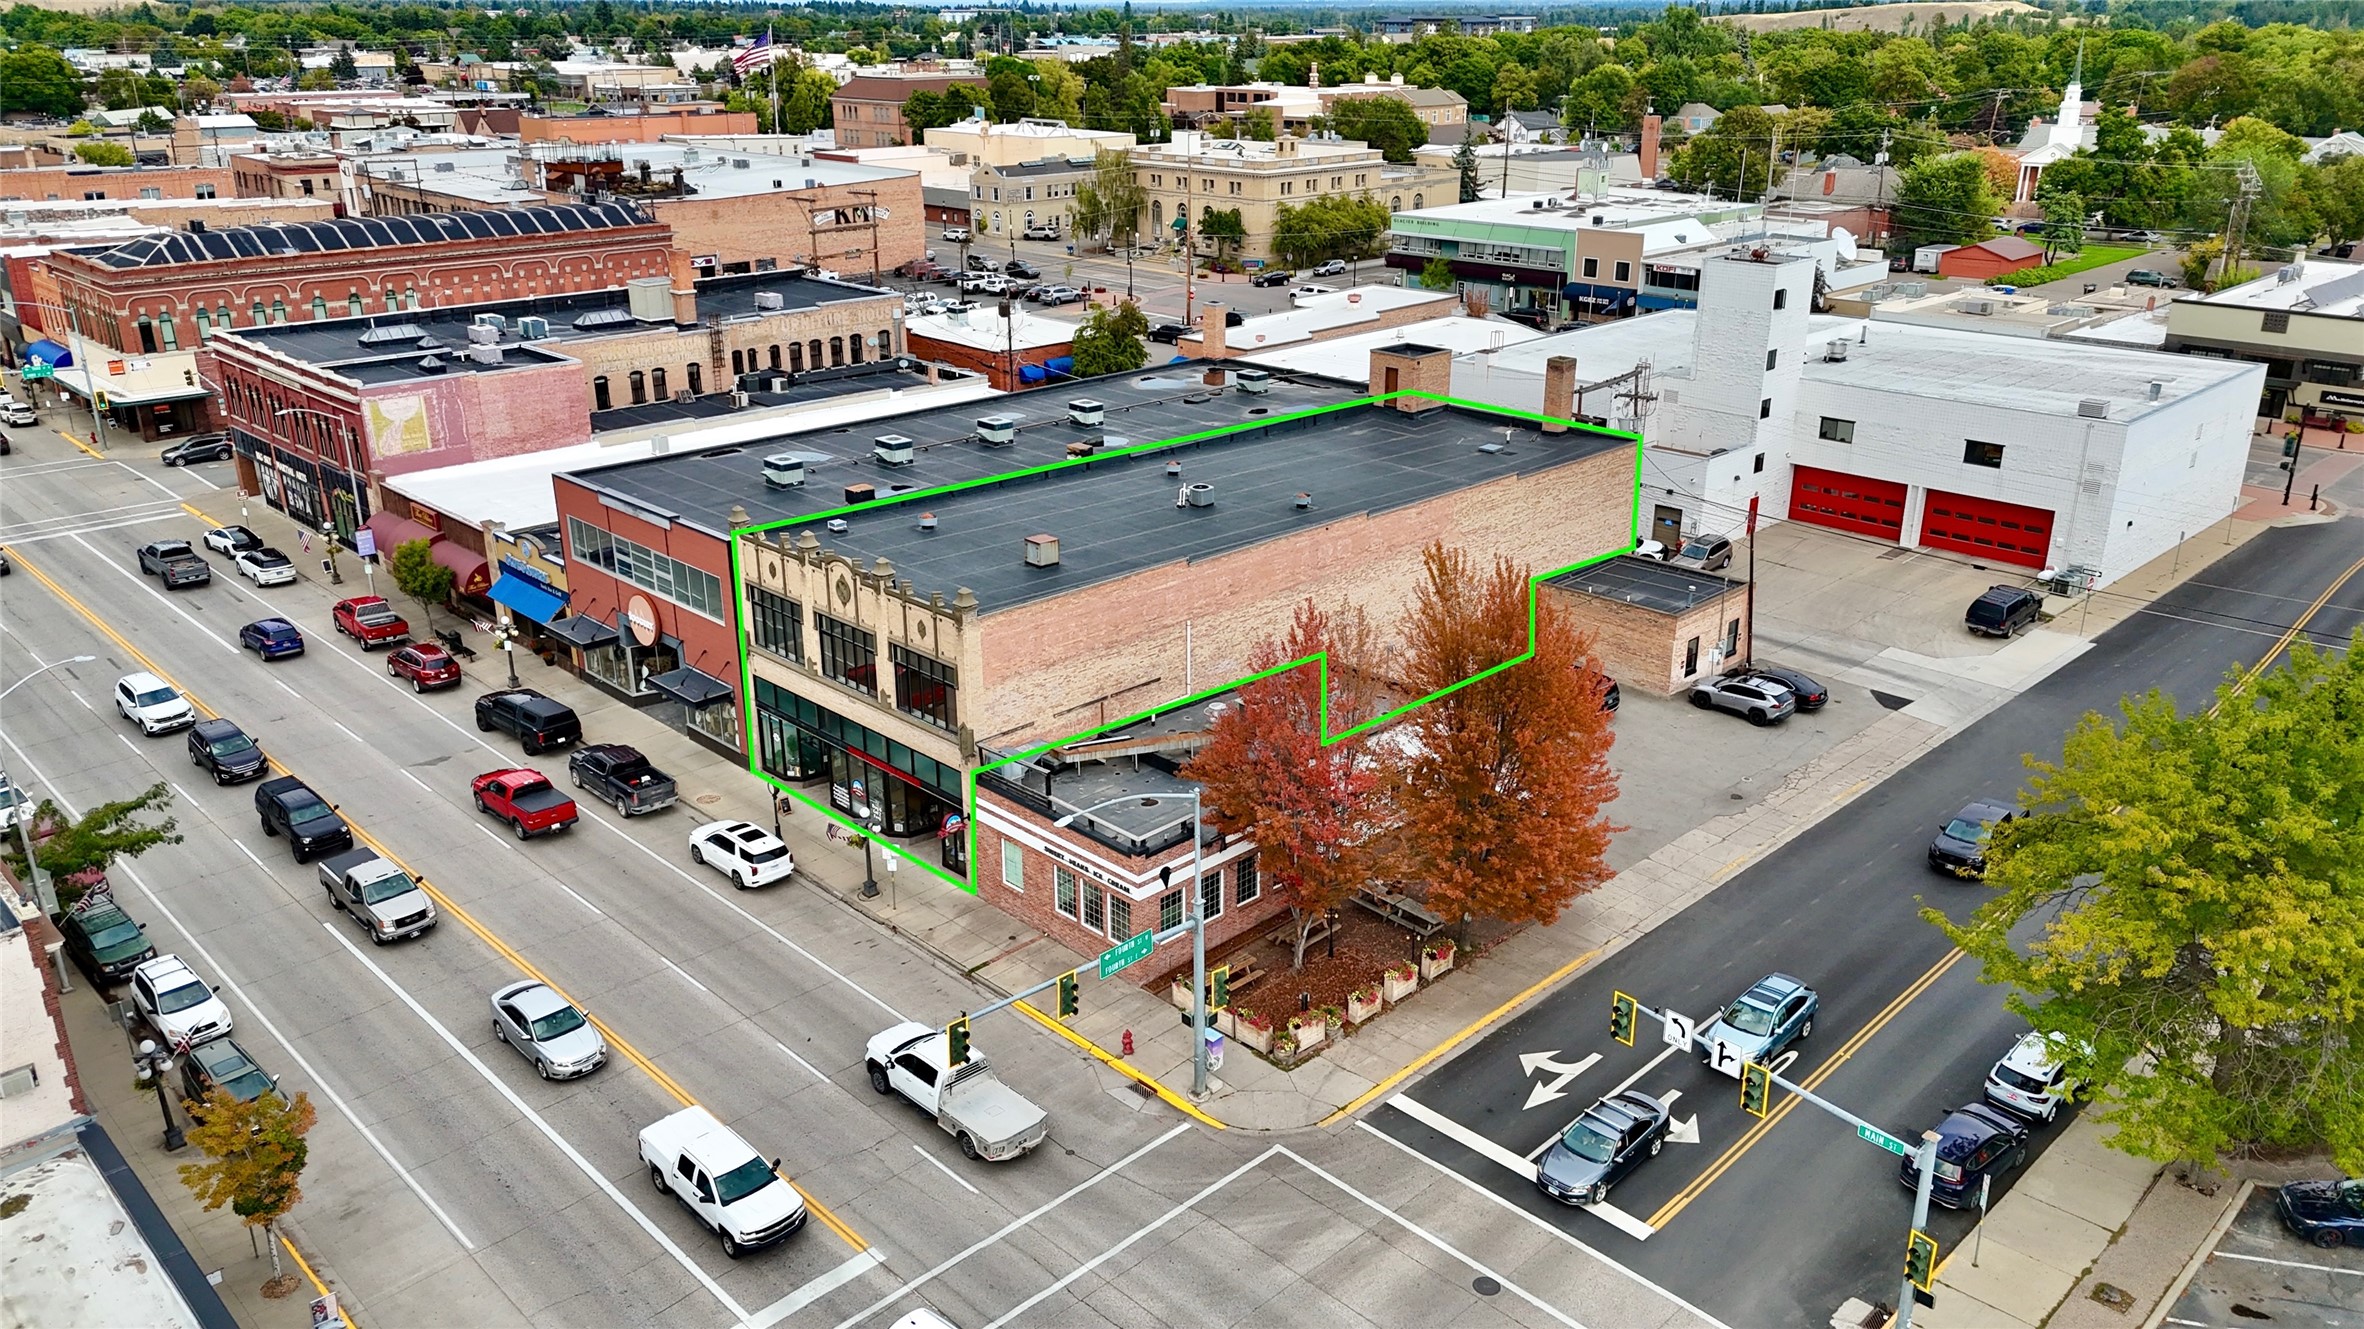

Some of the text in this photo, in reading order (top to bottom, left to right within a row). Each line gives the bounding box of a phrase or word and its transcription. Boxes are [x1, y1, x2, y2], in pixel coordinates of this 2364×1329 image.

[835, 206, 870, 225] KM
[1656, 264, 1677, 273] KOFI
[1044, 846, 1131, 894] SWEET PEAKS ICE CREAM
[1115, 940, 1135, 956] FOURTH
[1105, 958, 1125, 975] FOURTH
[1667, 1034, 1687, 1048] ONLY
[1865, 1129, 1898, 1150] MAIN ST
